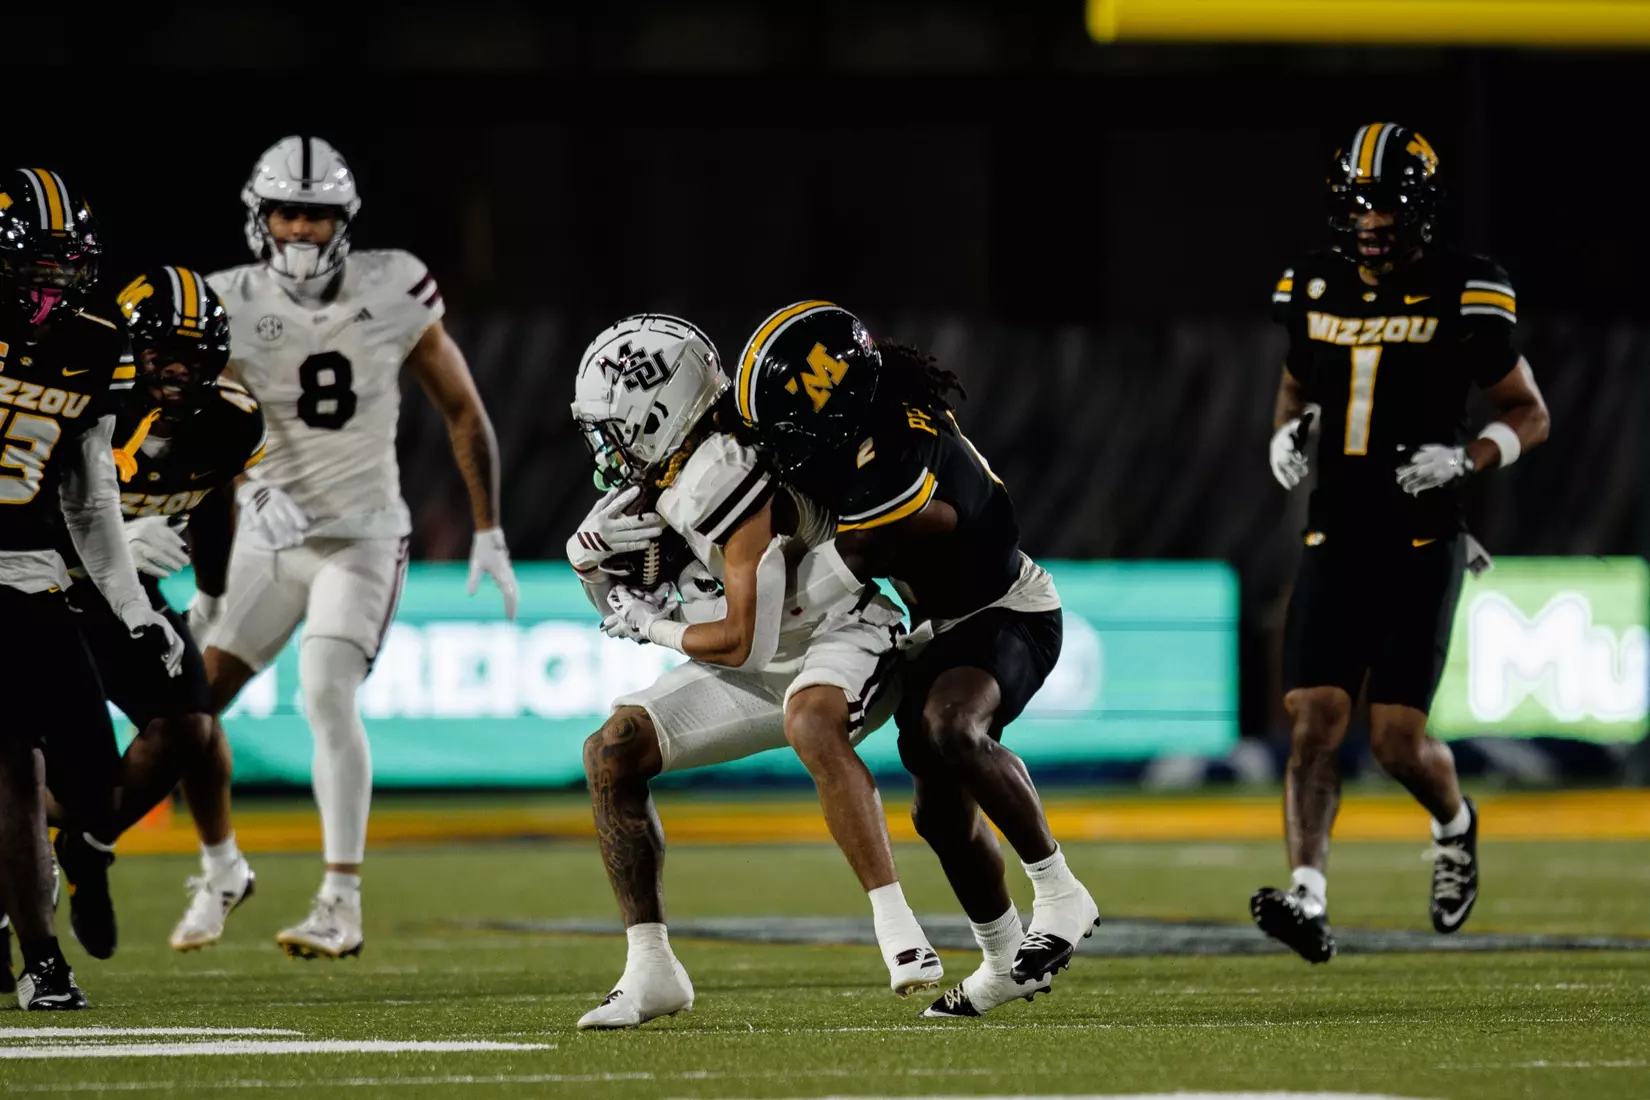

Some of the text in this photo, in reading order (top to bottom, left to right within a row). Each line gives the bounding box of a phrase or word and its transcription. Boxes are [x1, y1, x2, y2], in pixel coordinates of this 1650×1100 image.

[599, 341, 672, 393] MSU
[1307, 311, 1439, 346] MIZZOU
[298, 351, 357, 431] 8
[1343, 344, 1384, 456] 1
[0, 408, 61, 504] 3
[1468, 591, 1650, 722] Mu
